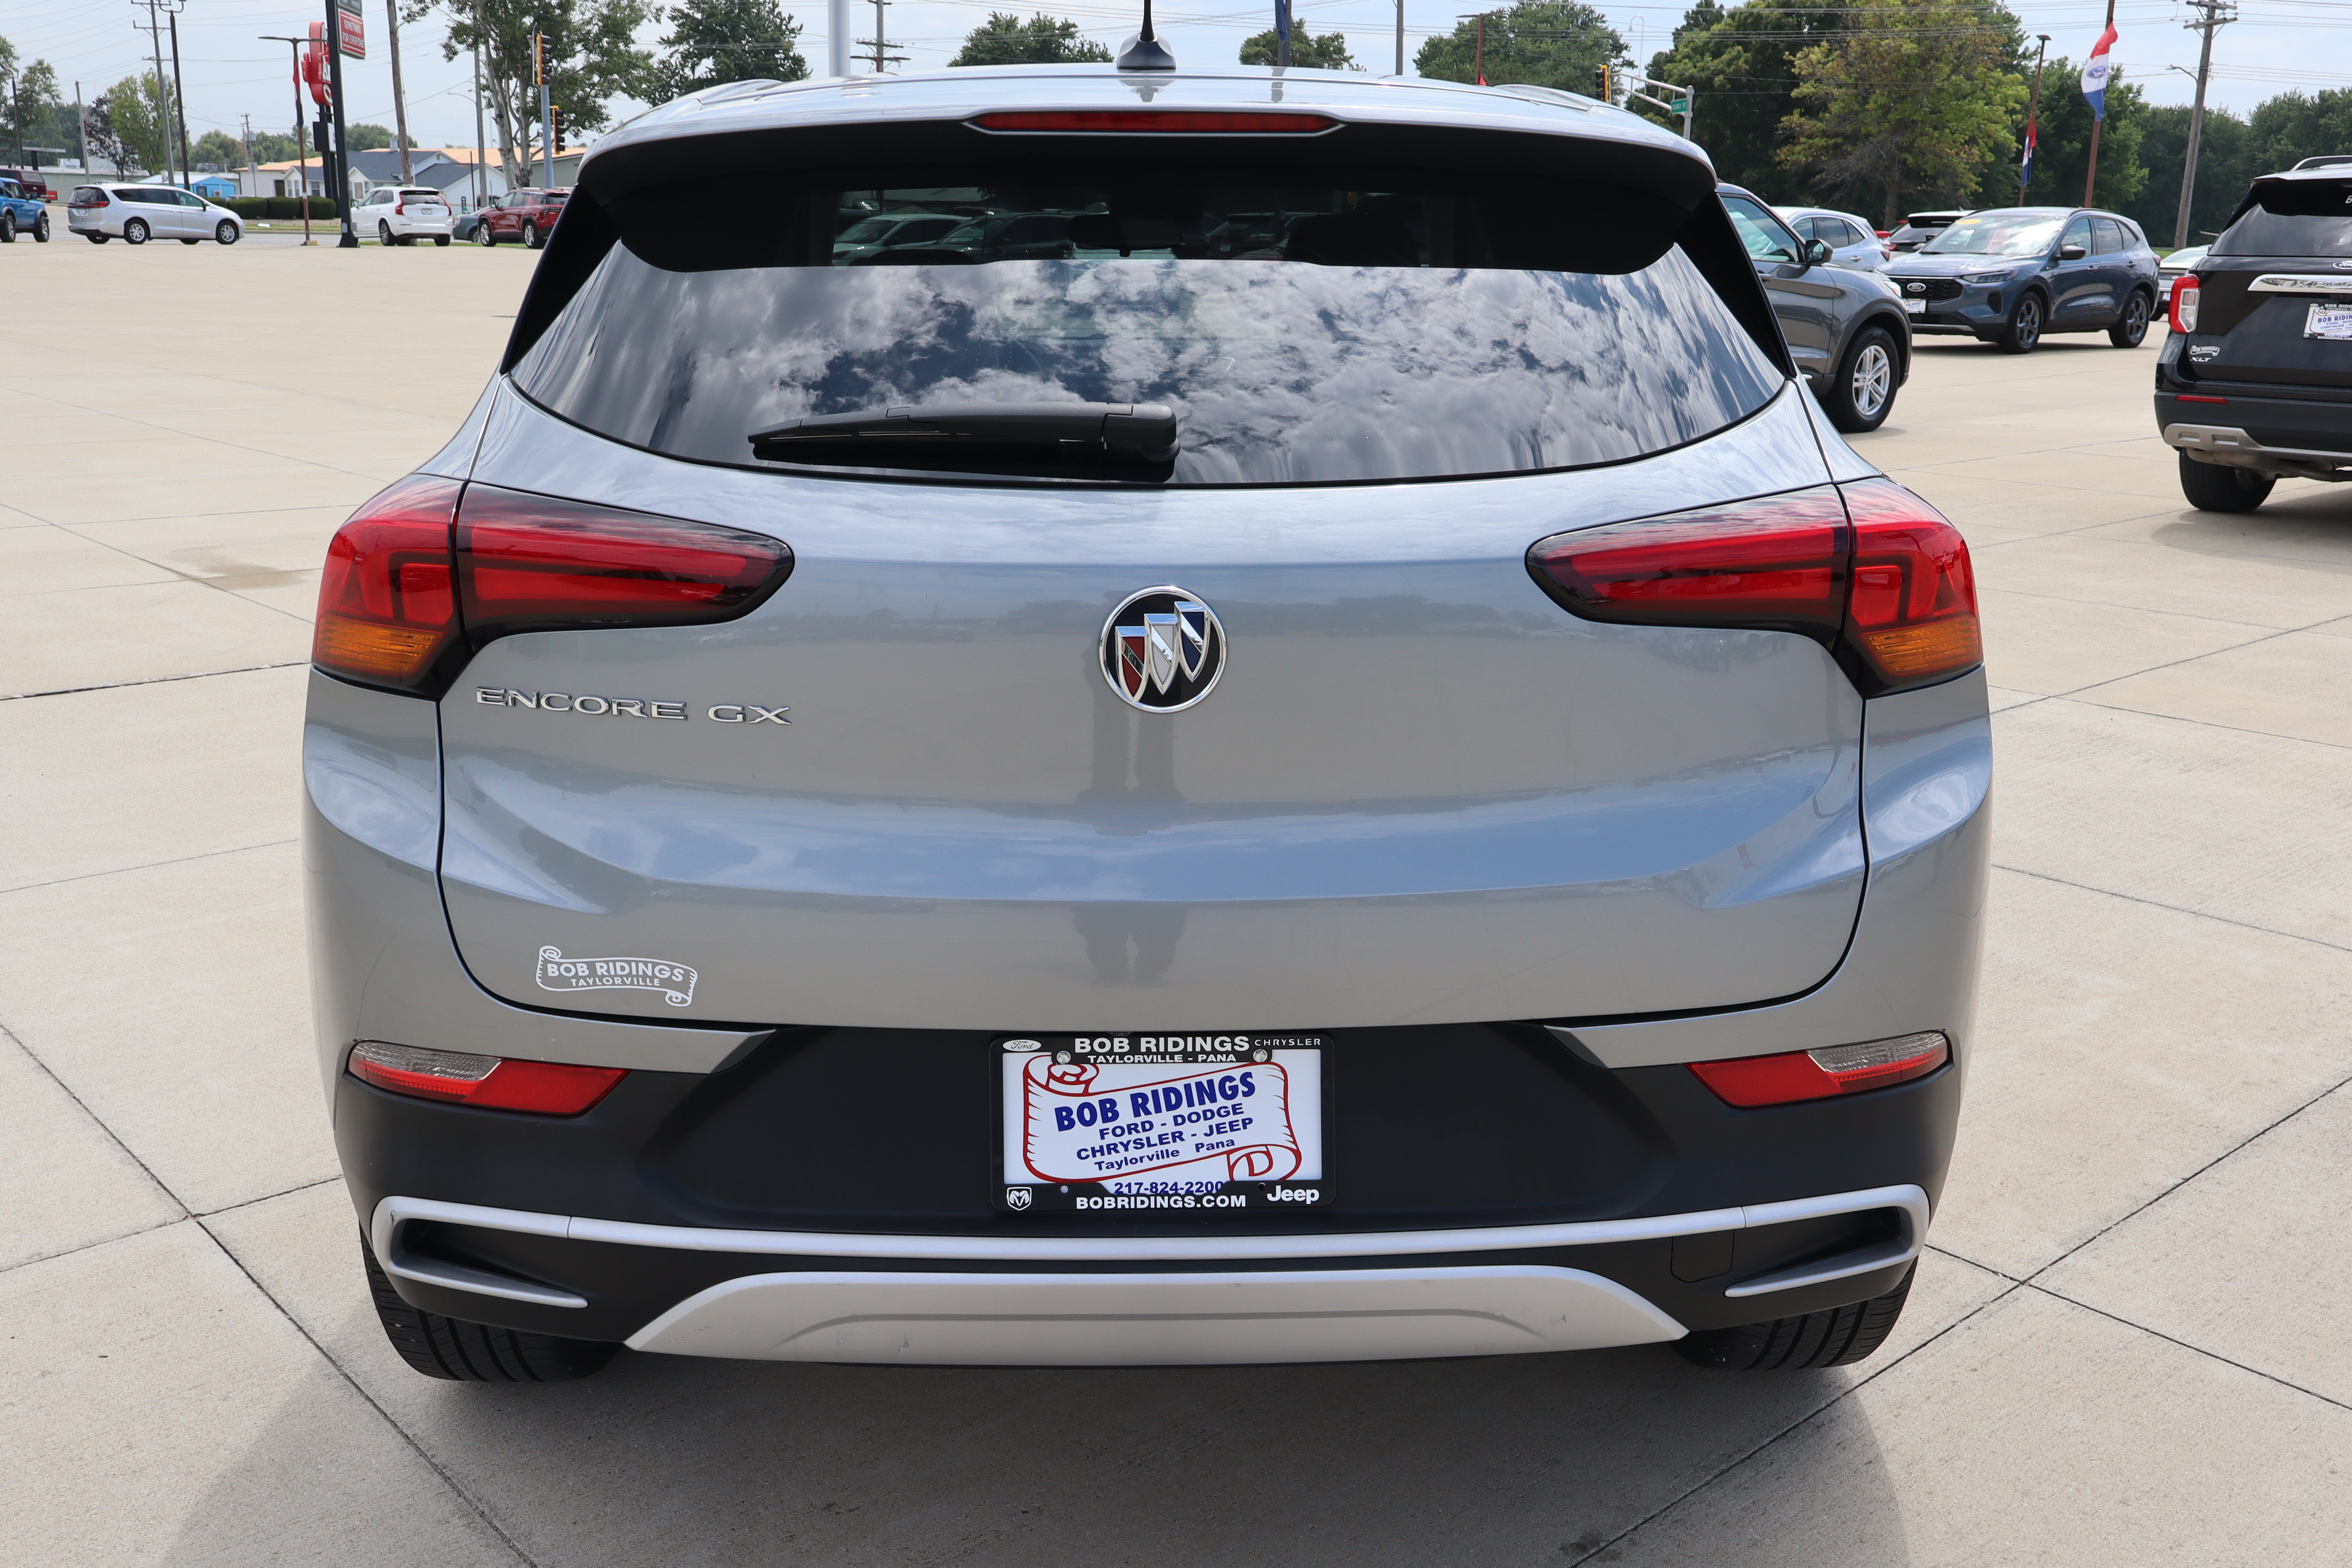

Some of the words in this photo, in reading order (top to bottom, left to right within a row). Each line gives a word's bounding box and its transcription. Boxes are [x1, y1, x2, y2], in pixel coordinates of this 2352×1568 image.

[349, 34, 364, 48] EVERYONE
[477, 686, 688, 720] ENCORE
[707, 704, 792, 725] GX
[547, 963, 589, 977] BOB
[595, 962, 684, 982] RIDINGS
[570, 977, 660, 987] TAYLORVILLE
[1011, 1040, 1034, 1049] Ford
[1075, 1038, 1130, 1053] BOB
[1140, 1036, 1250, 1052] RIDINGS
[1087, 1054, 1183, 1063] TAYLORVILLE
[1198, 1054, 1236, 1062] PANA
[1054, 1098, 1120, 1132] BOB
[1130, 1071, 1256, 1118] RIDINGS
[1099, 1120, 1154, 1140] FORD
[1173, 1102, 1245, 1127] DODGE
[1076, 1130, 1185, 1160] CHRYSLER
[1203, 1117, 1253, 1137] JEEP
[1094, 1147, 1180, 1171] Taylorville
[1195, 1139, 1235, 1153] Pana
[1114, 1181, 1225, 1194] 217-824-2200
[1267, 1185, 1320, 1204] Jeep
[1076, 1195, 1246, 1209] BOBRIDINGS.COM
